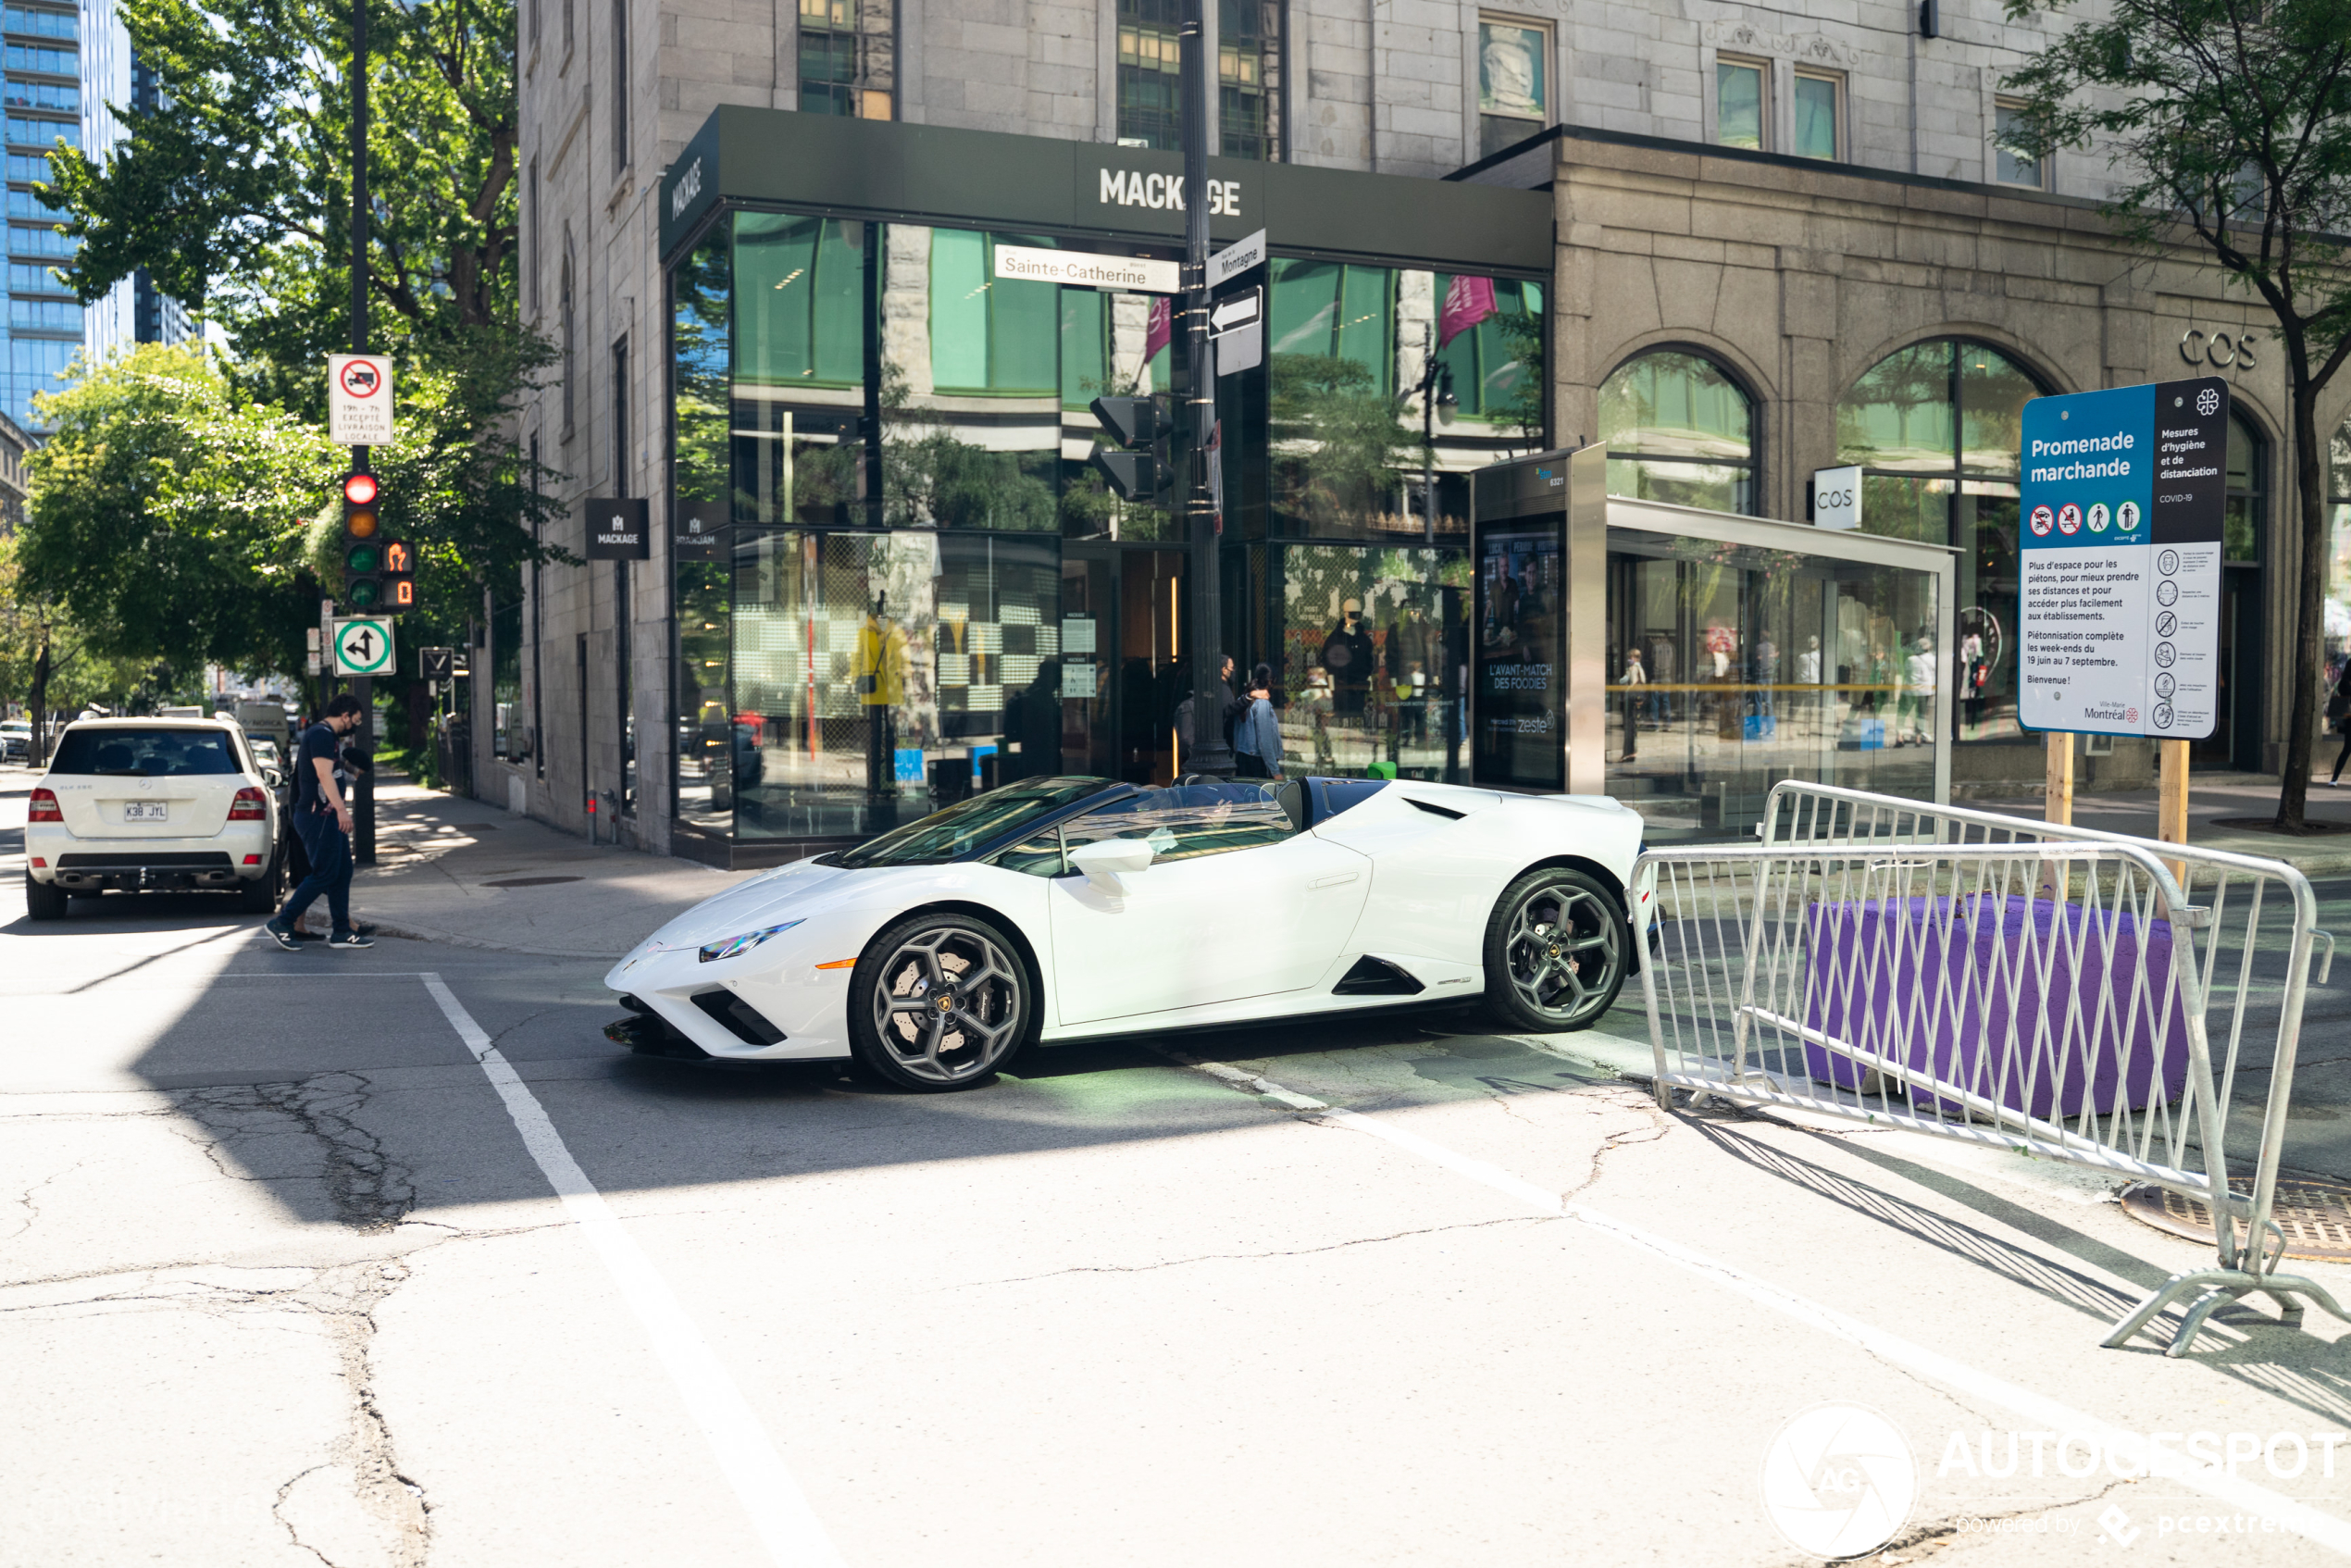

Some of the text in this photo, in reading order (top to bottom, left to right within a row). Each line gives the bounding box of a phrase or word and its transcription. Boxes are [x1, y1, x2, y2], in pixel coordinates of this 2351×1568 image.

[1100, 168, 1240, 217] MACKGE
[1222, 248, 1257, 276] Montagne
[1005, 257, 1146, 284] Sainte-Catherine
[2179, 329, 2257, 370] COS
[342, 413, 380, 421] EXCEPTÉ
[338, 423, 386, 431] LIVRAISON
[2162, 429, 2198, 439] Mesures
[2032, 431, 2134, 457] Promenade
[2161, 441, 2206, 454] d'hygiène
[2160, 455, 2183, 466] et de
[2031, 457, 2131, 482] marchande
[2160, 467, 2218, 479] distanciation
[1549, 477, 1564, 487] 6321
[1817, 489, 1853, 509] COS
[2159, 494, 2193, 504] COVID-19
[598, 533, 639, 544] MACKAGE
[2029, 560, 2118, 571] Plus d'espace pour les
[2028, 572, 2139, 584] piétons, pour mieux prendre
[398, 581, 412, 604] 0
[2042, 587, 2079, 595] distances
[2092, 587, 2111, 596] pour
[2028, 599, 2122, 609] accéder plus facilement
[2043, 611, 2105, 620] établissements.
[2027, 631, 2124, 641] Piétonnisation complète
[2027, 643, 2095, 653] les week-ends du
[2027, 656, 2034, 665] 19
[2036, 656, 2051, 666] juin
[2071, 657, 2118, 667] septembre.
[1489, 664, 1552, 677] L'AVANT-MATCH
[1494, 678, 1547, 690] DES FOODIES
[2084, 708, 2125, 720] Montréal
[1518, 716, 1547, 733] zeste
[127, 806, 165, 816] K38 JYL
